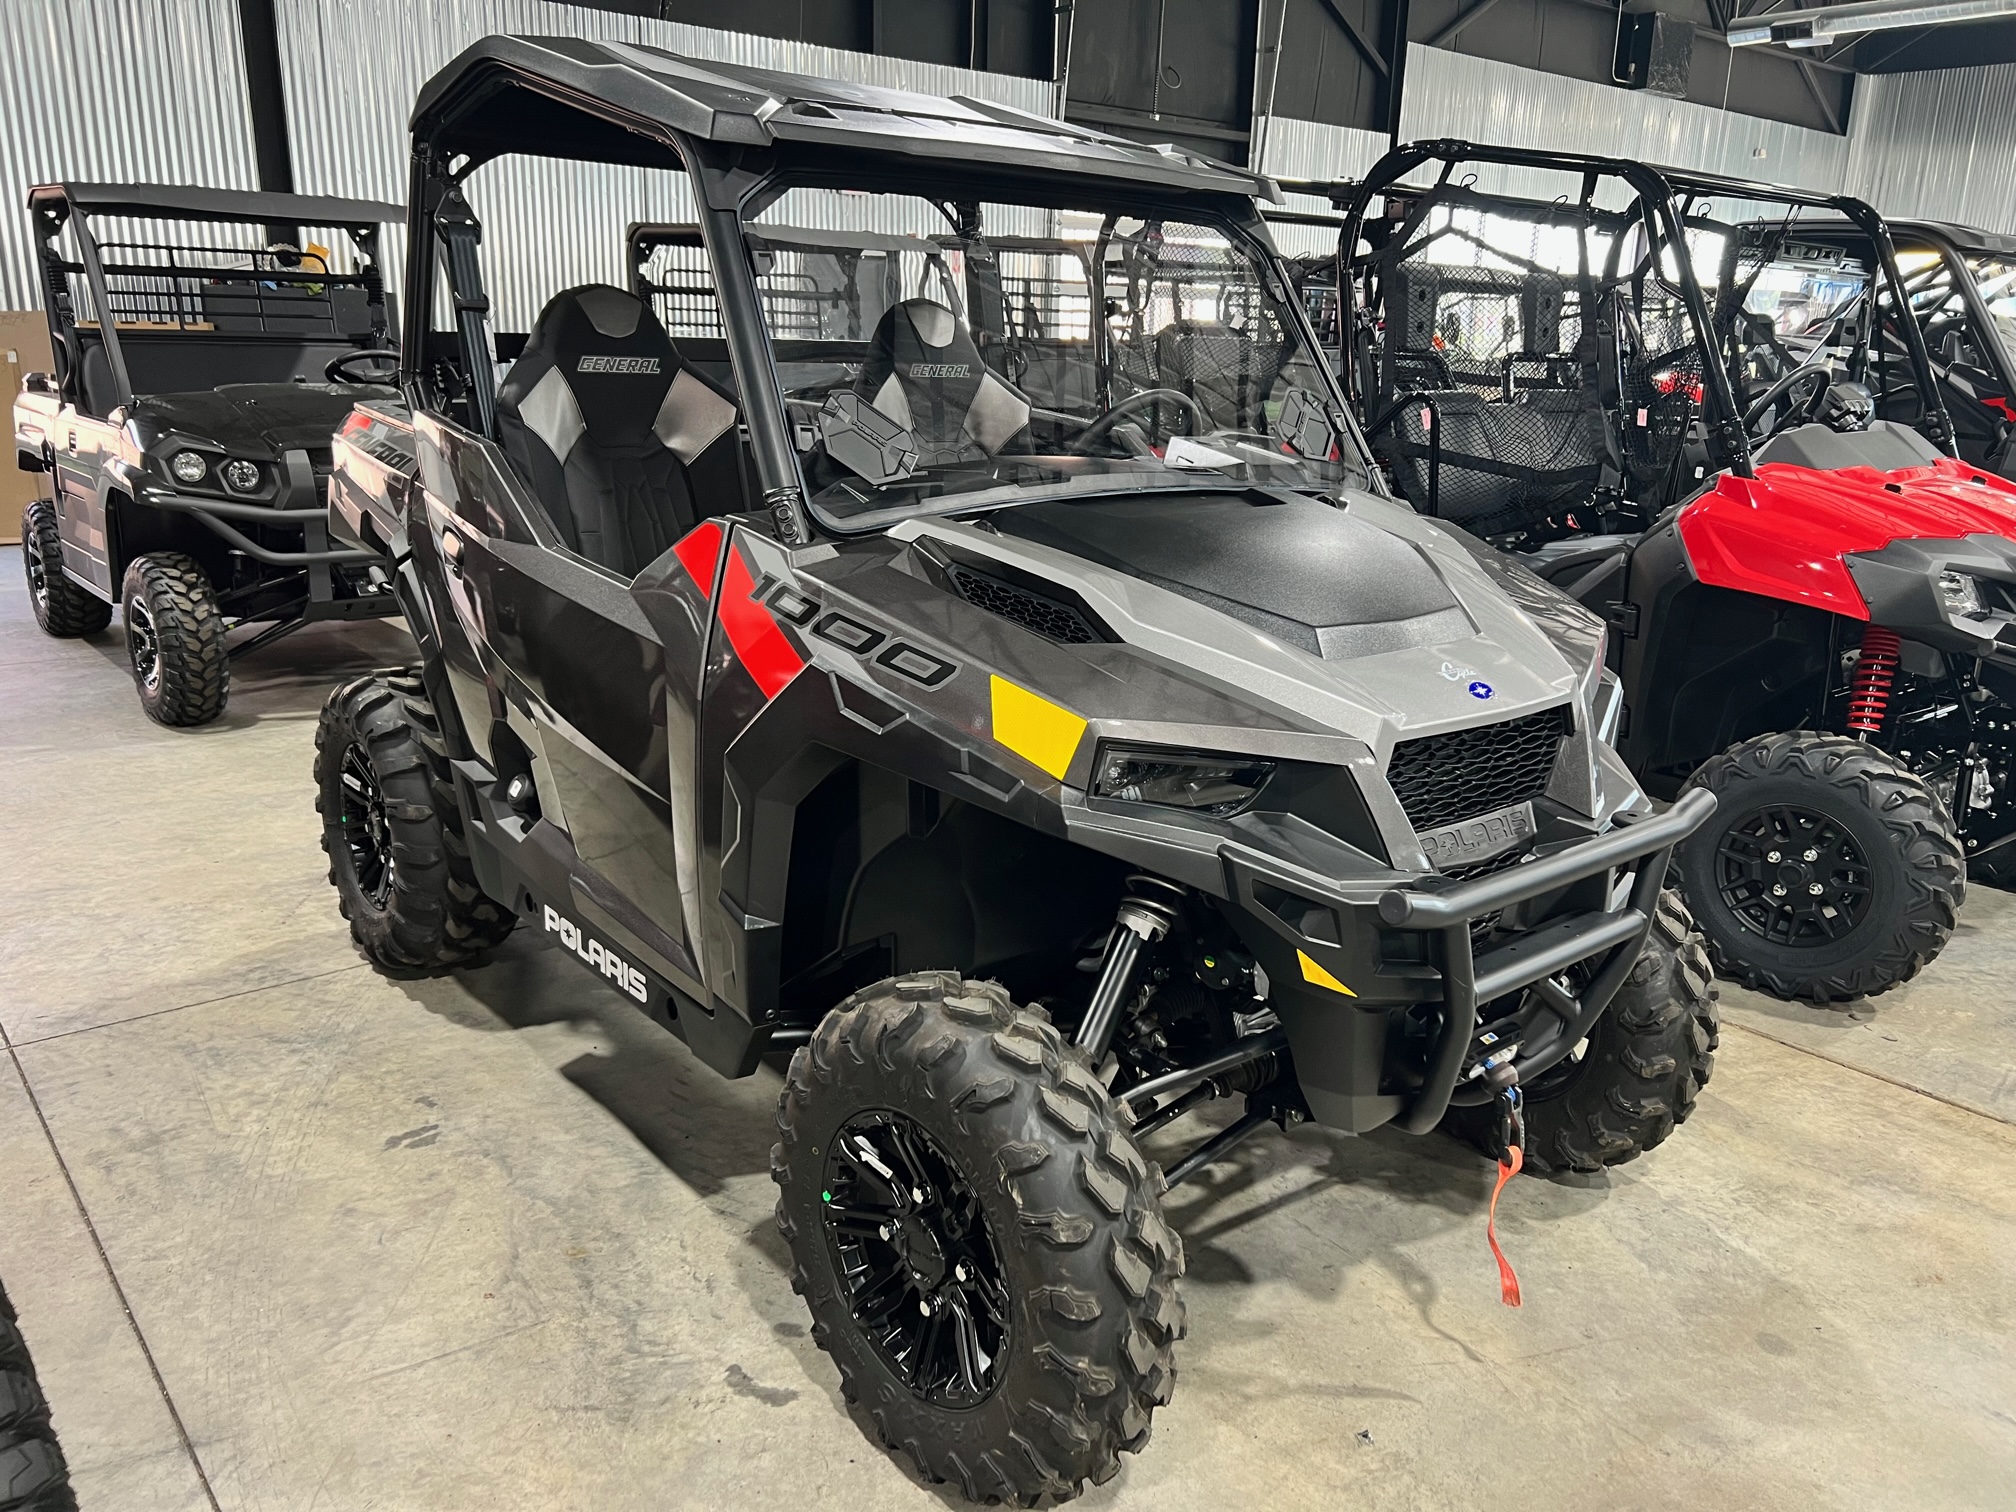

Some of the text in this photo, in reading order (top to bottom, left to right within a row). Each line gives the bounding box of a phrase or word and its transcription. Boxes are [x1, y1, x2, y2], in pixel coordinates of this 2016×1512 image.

[577, 356, 661, 374] GENERAL
[909, 363, 971, 378] GENERAL
[748, 571, 963, 692] 1000
[1419, 810, 1528, 857] POLARIS
[544, 904, 648, 1003] POLARIS
